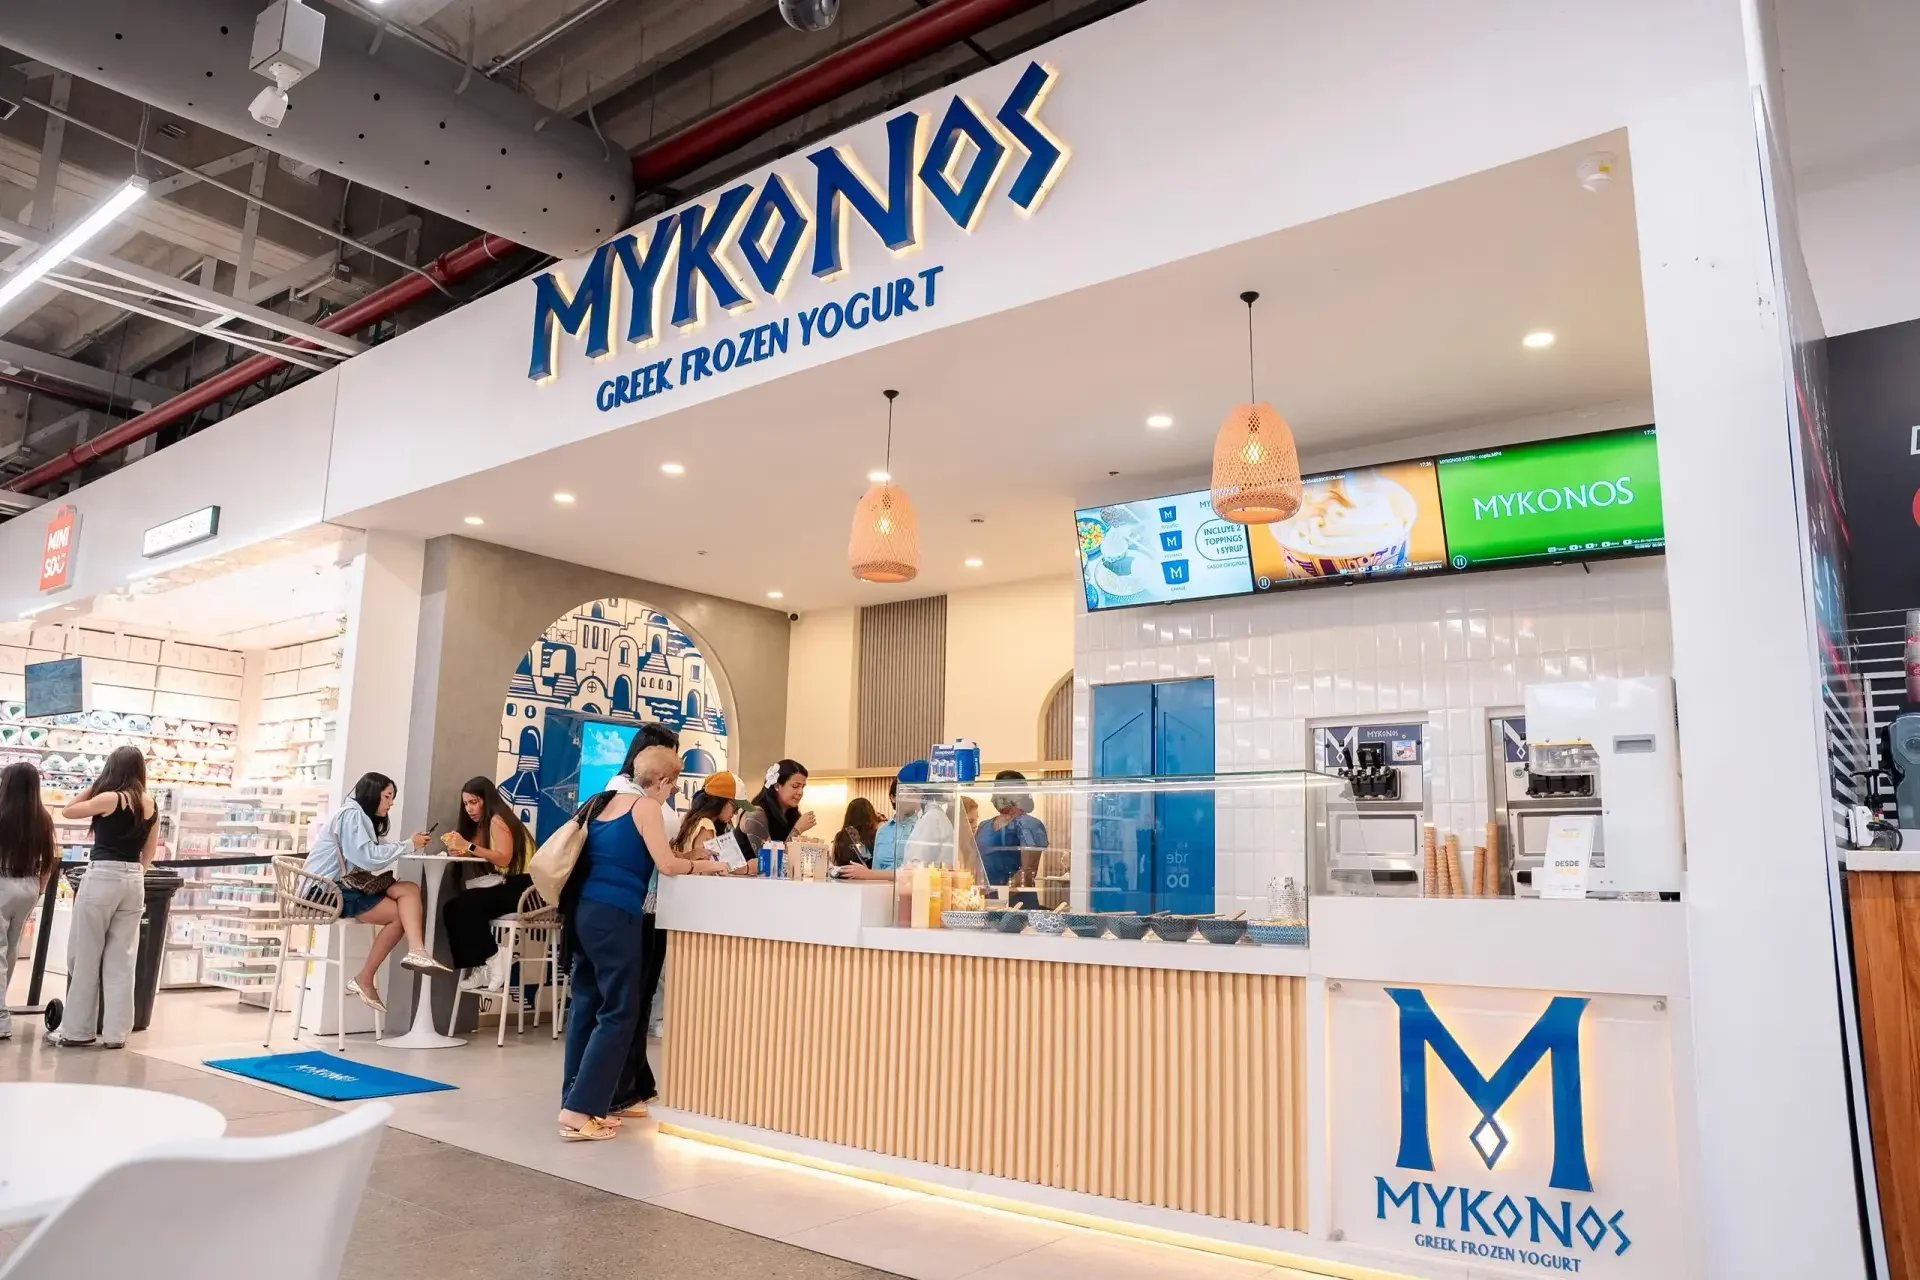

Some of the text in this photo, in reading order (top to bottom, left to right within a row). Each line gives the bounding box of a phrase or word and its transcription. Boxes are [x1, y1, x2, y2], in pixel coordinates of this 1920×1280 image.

[528, 61, 1064, 381] MYKONOS
[596, 265, 944, 412] GREEK FROZEN YOGURT
[1472, 476, 1635, 521] MYKONOS
[48, 526, 71, 552] MINI
[1166, 536, 1178, 547] M
[1204, 523, 1242, 536] INCLUYE 2
[1205, 534, 1243, 546] TOPPINGS
[1221, 544, 1244, 554] SYRUP
[1170, 566, 1183, 580] M
[1366, 730, 1399, 738] MYKONOS
[1383, 987, 1595, 1193] M
[1374, 1175, 1632, 1257] MYKONOS
[1415, 1233, 1582, 1273] GREEK FROZEN YOGURT
